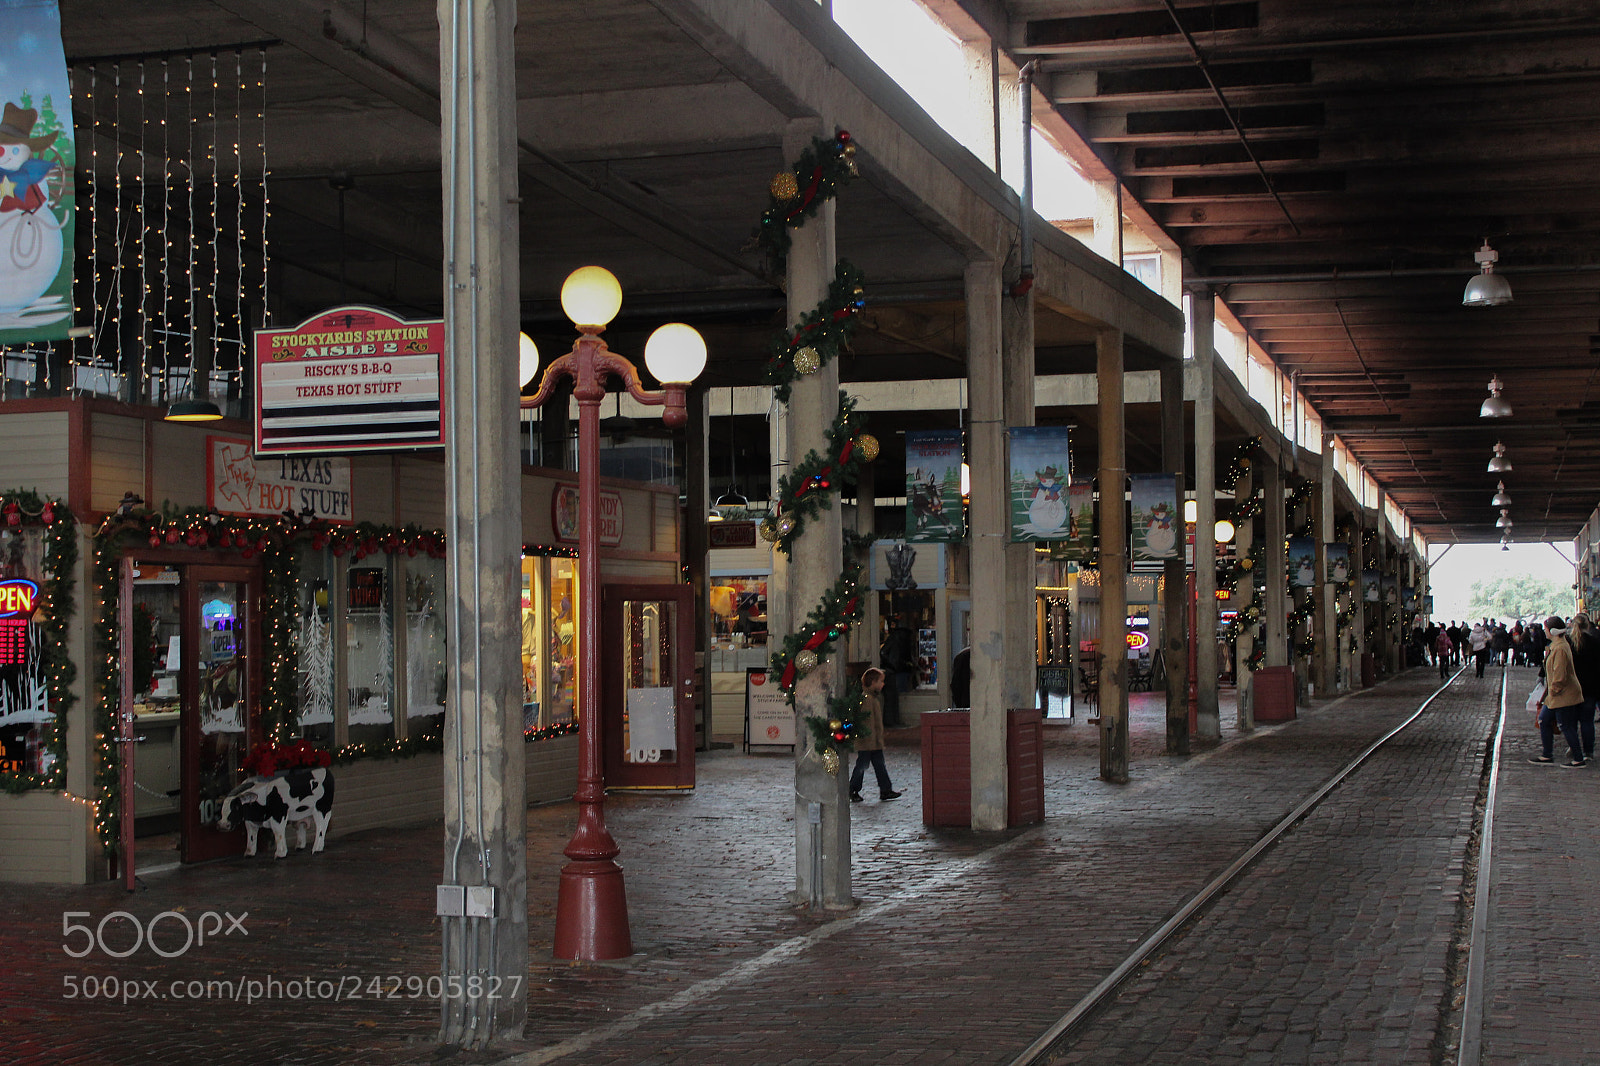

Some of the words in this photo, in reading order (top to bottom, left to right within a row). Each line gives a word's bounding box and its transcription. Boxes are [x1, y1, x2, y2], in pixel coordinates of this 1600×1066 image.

[271, 331, 363, 348] STOCKYARDS
[366, 327, 429, 343] STATION
[301, 344, 377, 358] AISLE
[383, 343, 399, 353] 2
[304, 364, 358, 377] RISCKY'S
[361, 362, 392, 375] B-B-Q
[296, 385, 334, 398] TEXAS
[337, 384, 362, 396] HOT
[364, 382, 402, 395] STUFF
[227, 463, 252, 488] THS
[280, 458, 332, 486] TEXAS
[258, 483, 295, 511] HOT
[299, 487, 350, 516] STUFF
[599, 497, 619, 517] NDY
[600, 518, 620, 538] REL
[0, 587, 32, 611] PEN
[1215, 590, 1229, 599] PEN
[213, 635, 231, 652] OPEN
[1126, 634, 1144, 646] PEN
[626, 748, 661, 763] 109
